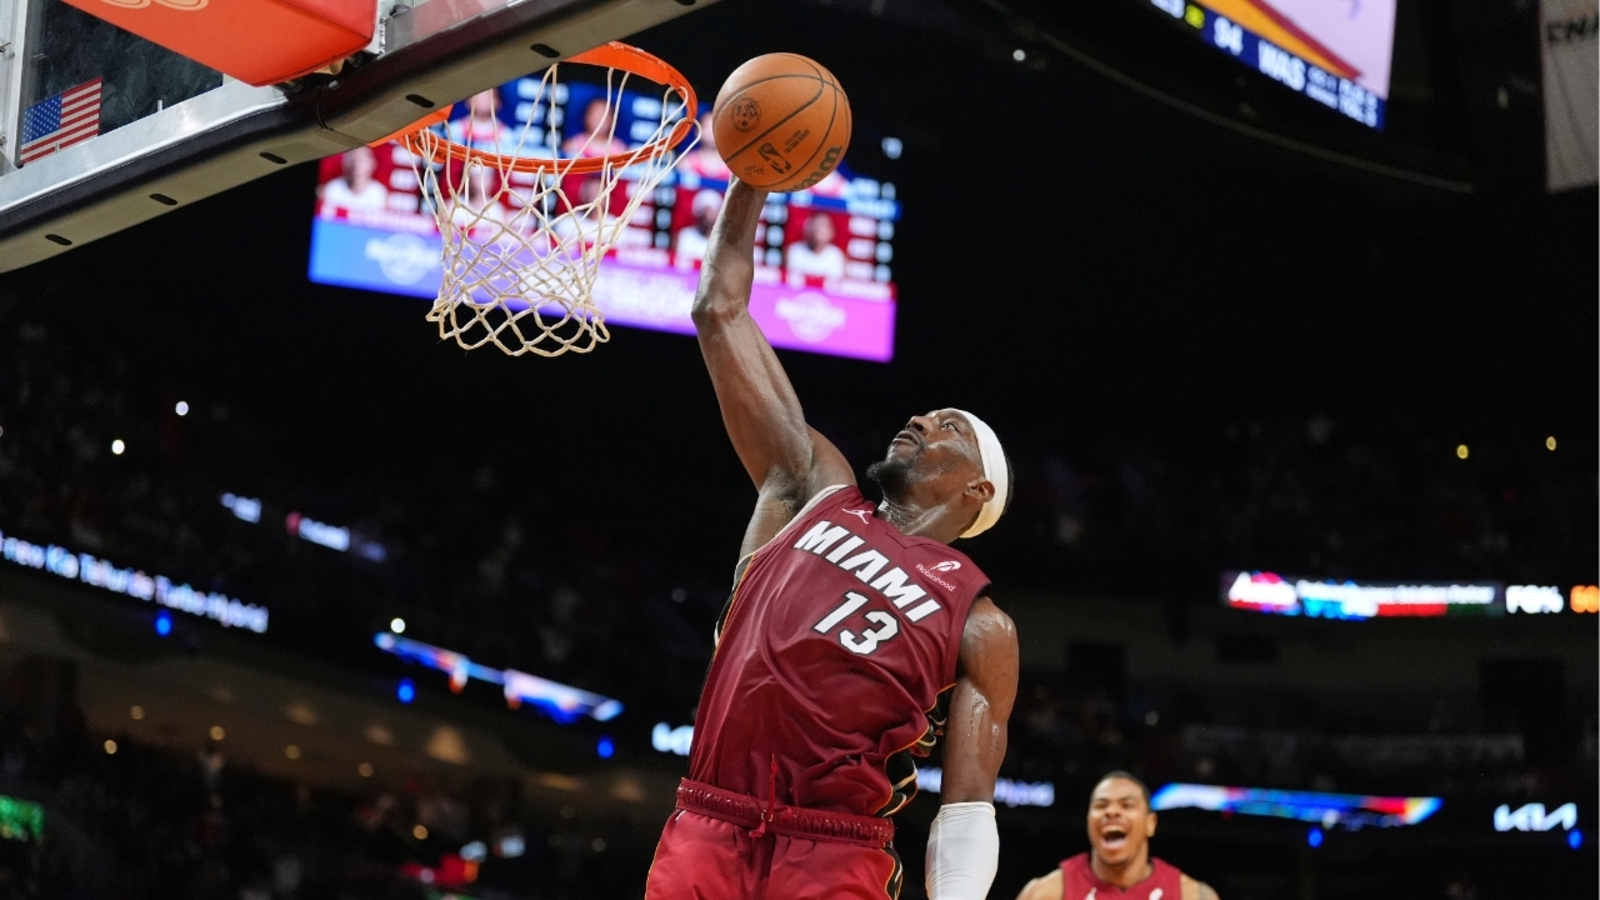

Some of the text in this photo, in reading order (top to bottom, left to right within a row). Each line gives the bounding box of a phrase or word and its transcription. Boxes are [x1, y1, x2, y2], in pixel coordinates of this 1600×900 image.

[1258, 40, 1306, 91] WAS
[793, 520, 942, 623] MIAMI
[915, 563, 956, 592] Robinhood
[813, 590, 899, 655] 13
